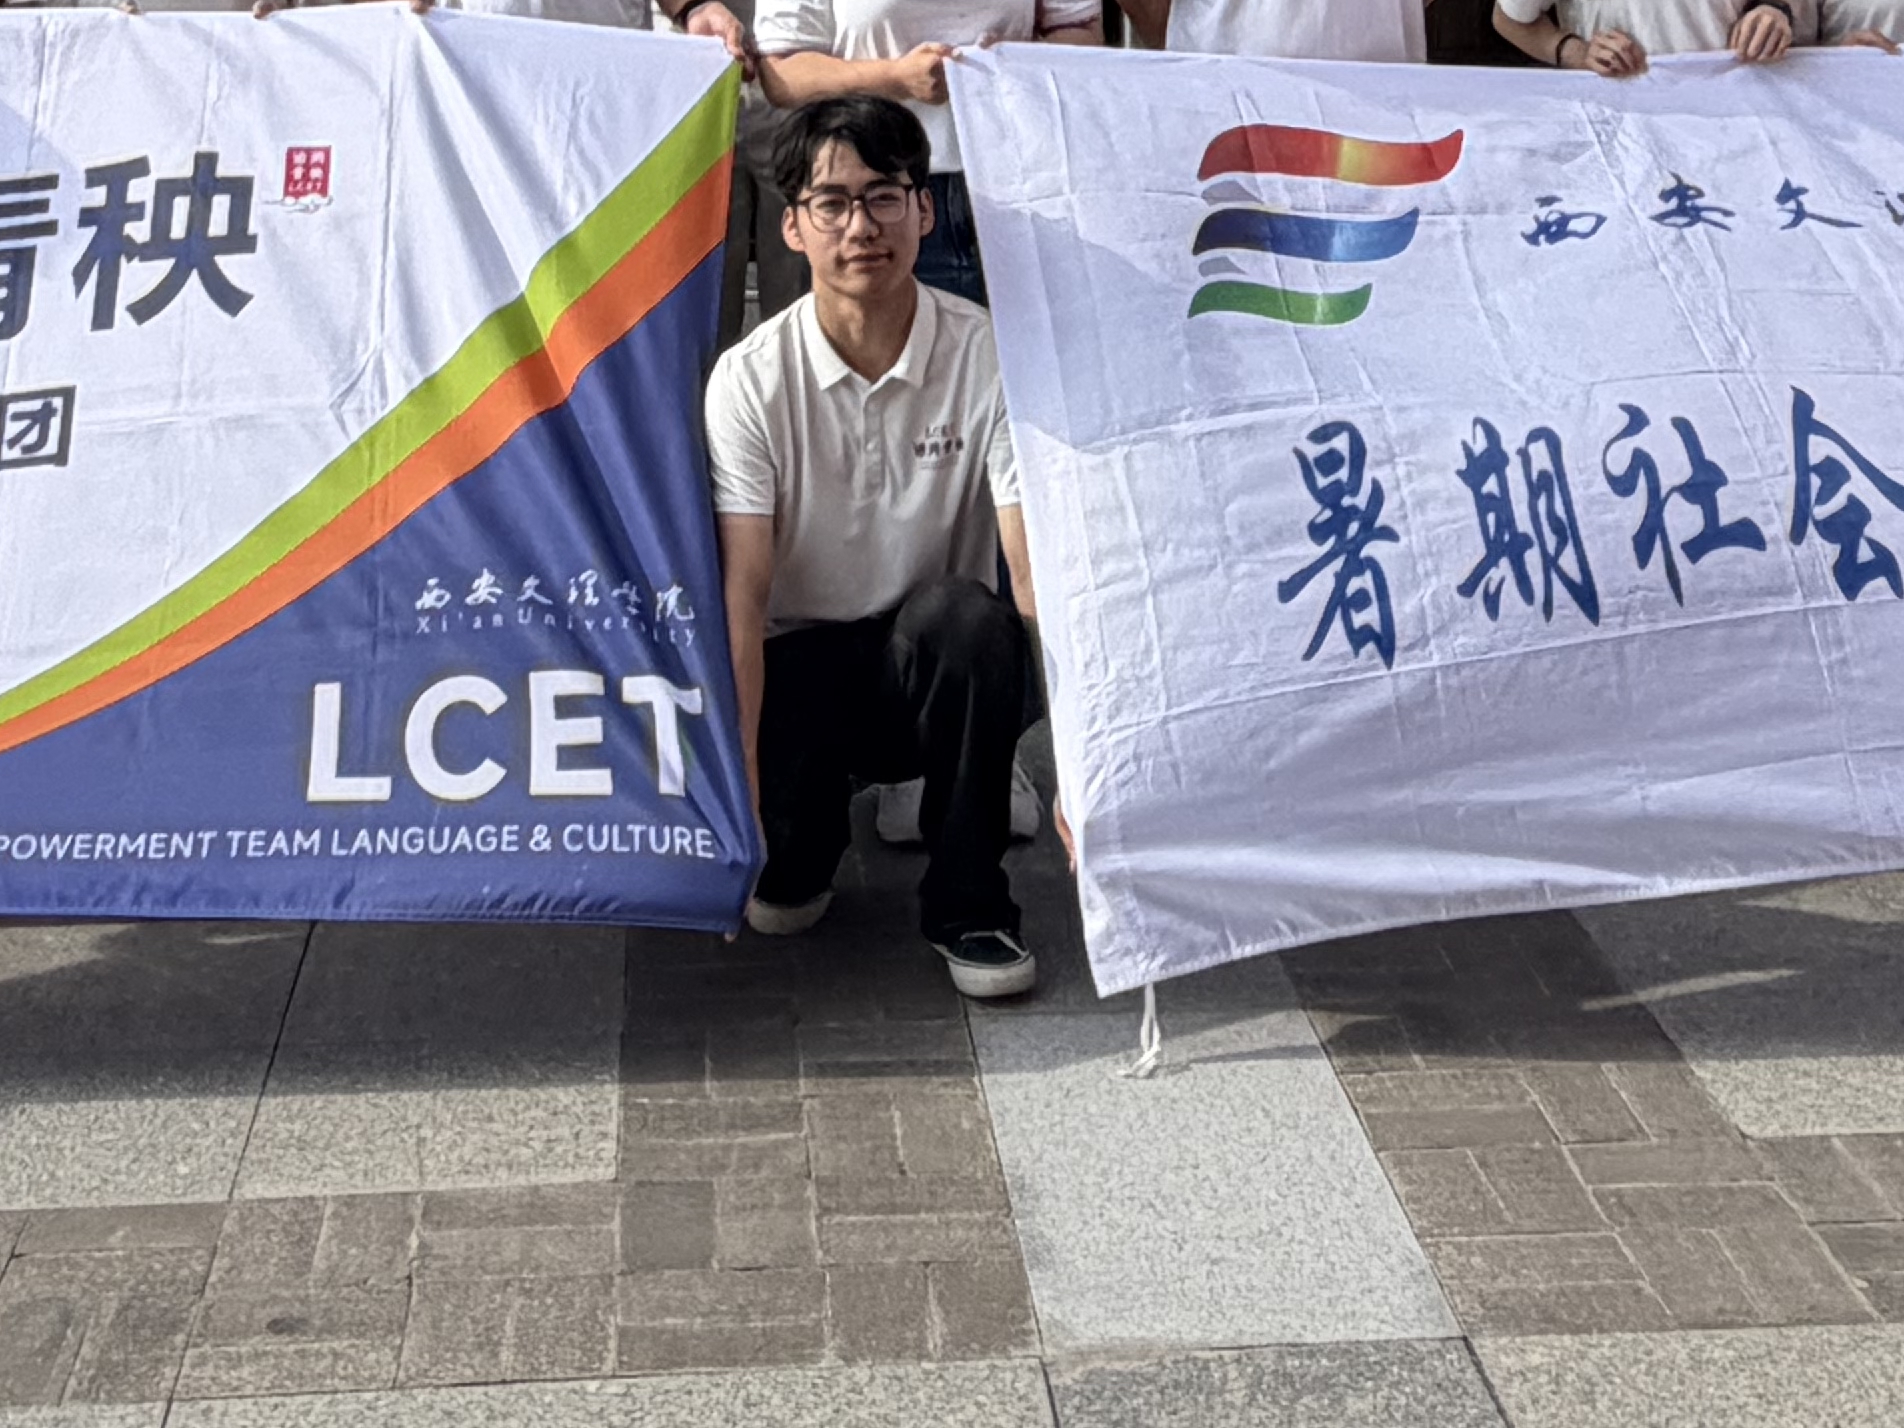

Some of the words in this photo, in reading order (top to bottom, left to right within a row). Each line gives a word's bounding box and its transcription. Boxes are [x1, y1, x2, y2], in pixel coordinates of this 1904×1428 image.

[307, 669, 702, 803] LCET
[226, 826, 321, 859] TEAM
[332, 824, 520, 858] LANGUAGE
[530, 825, 553, 855] &
[563, 823, 715, 860] CULTURE
